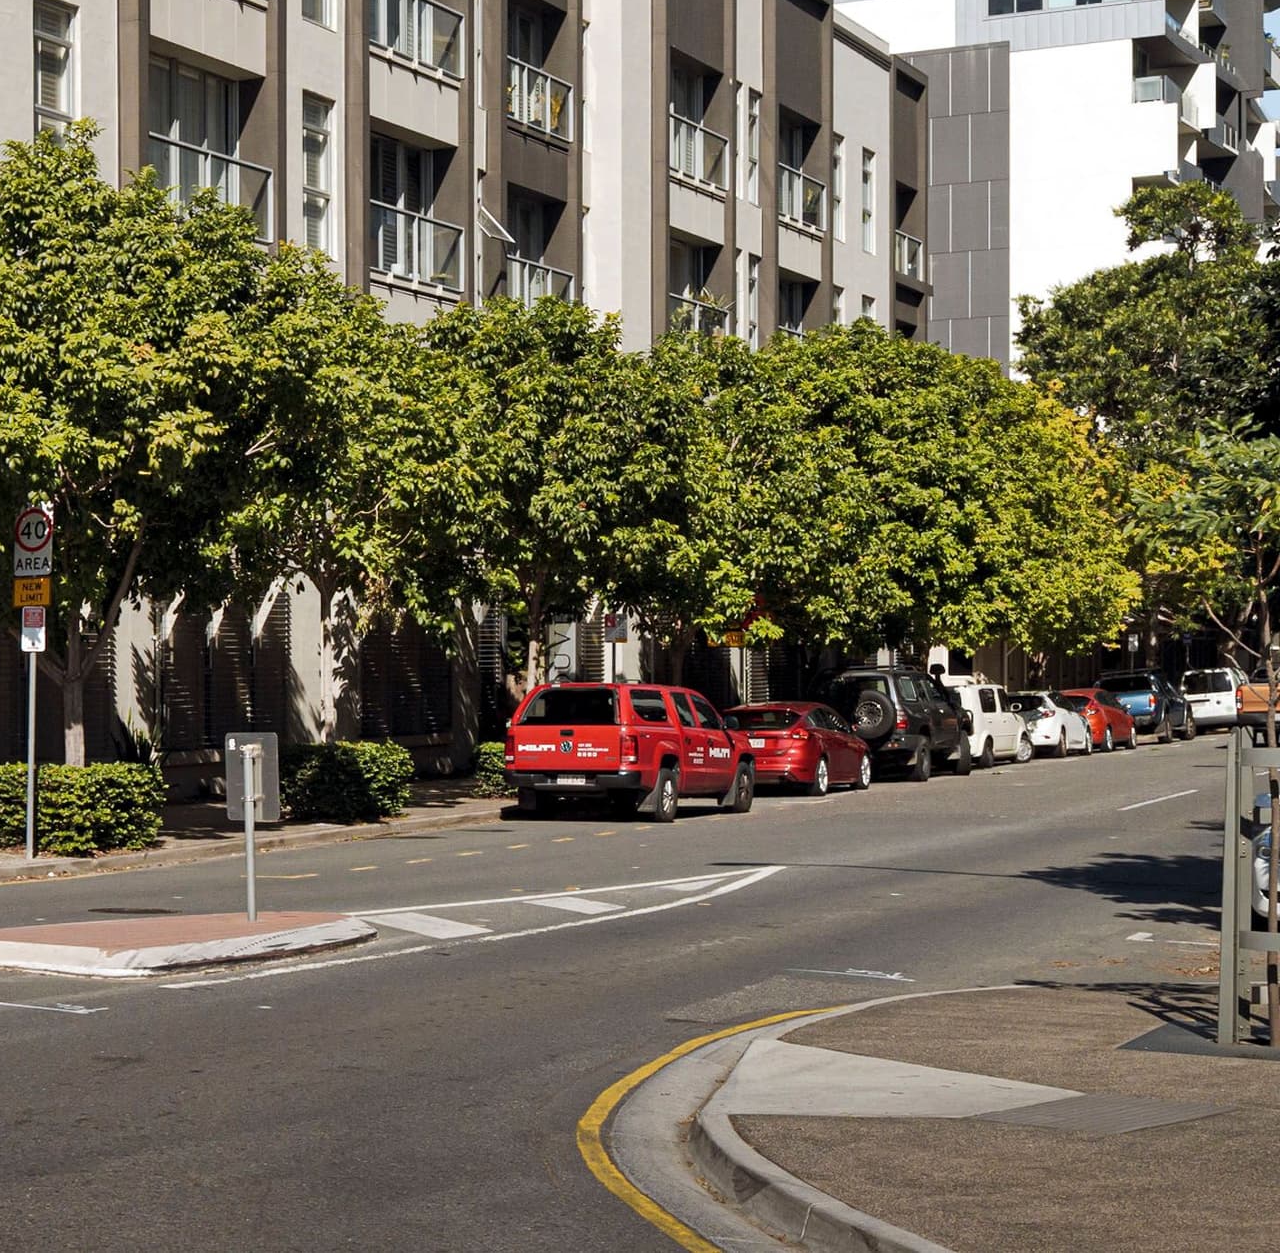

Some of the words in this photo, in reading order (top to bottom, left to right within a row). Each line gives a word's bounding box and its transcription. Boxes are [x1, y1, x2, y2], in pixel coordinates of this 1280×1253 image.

[20, 520, 46, 540] 40
[16, 557, 50, 571] AREA
[22, 582, 43, 592] NEW
[20, 593, 44, 603] LIMIT
